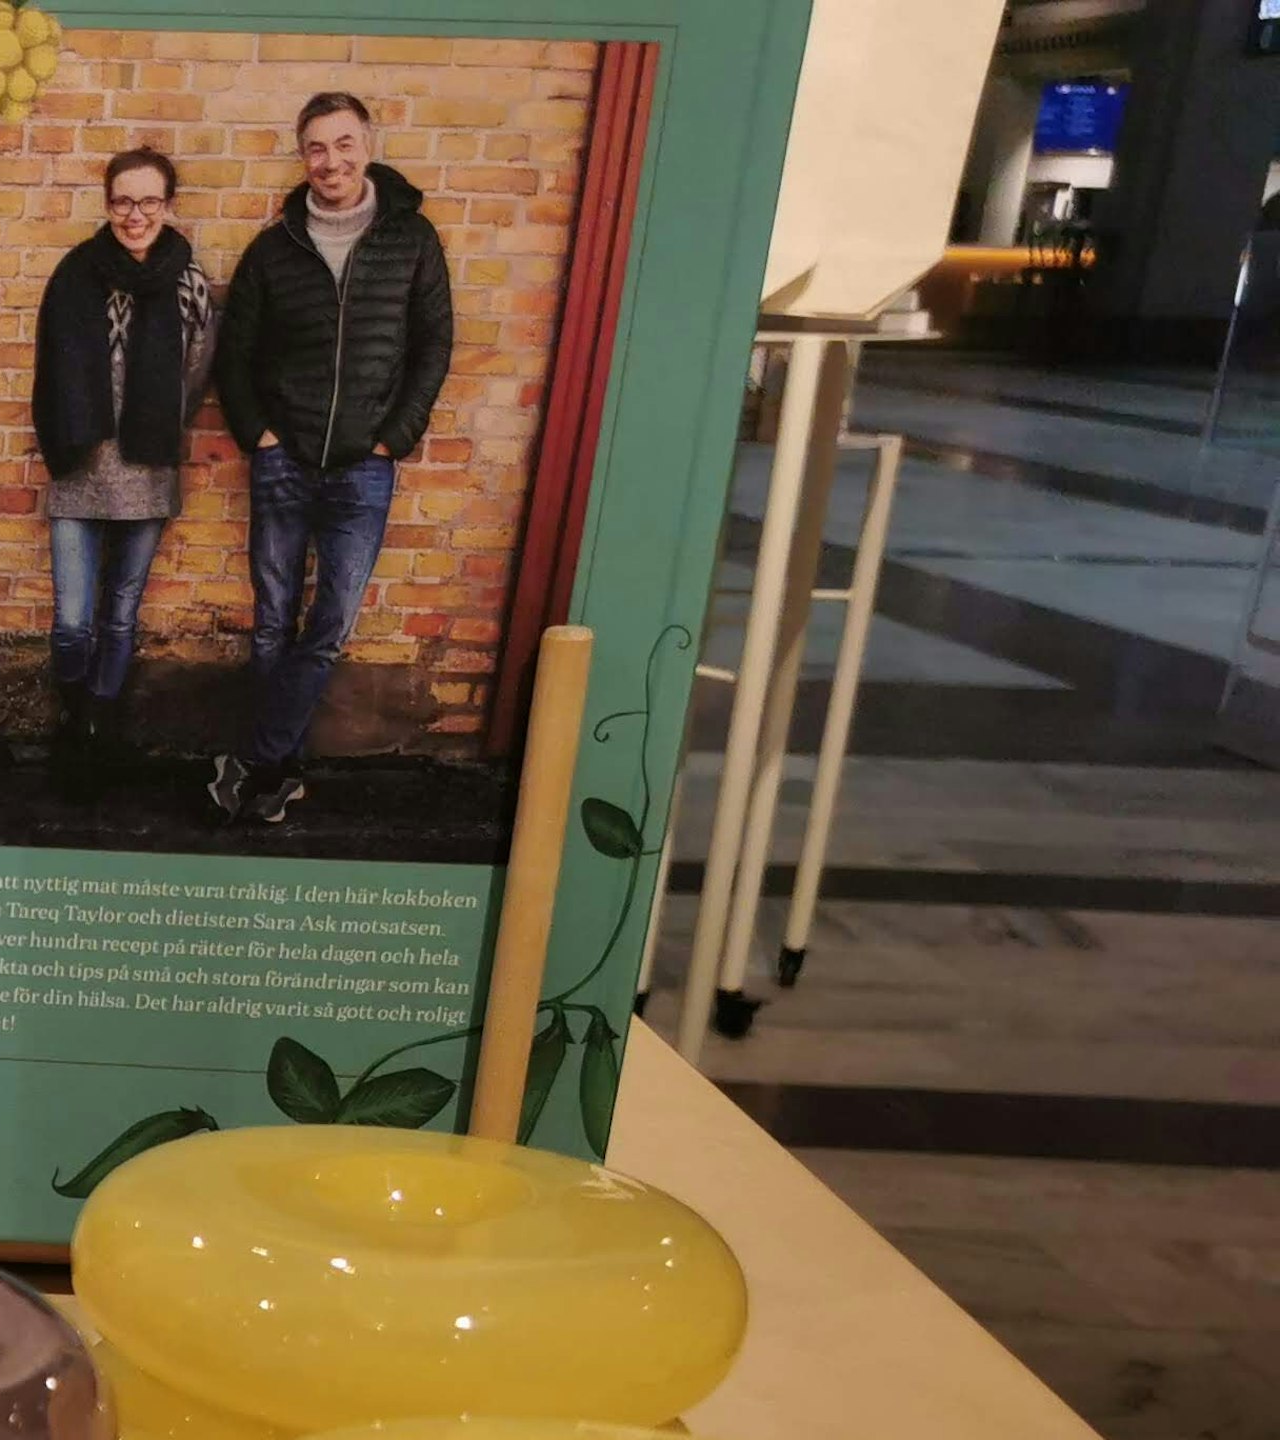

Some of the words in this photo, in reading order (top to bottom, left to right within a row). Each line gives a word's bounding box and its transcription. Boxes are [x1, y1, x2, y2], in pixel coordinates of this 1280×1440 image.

[24, 876, 79, 896] nyttig
[82, 879, 117, 895] mat
[123, 879, 180, 897] måste
[183, 884, 224, 899] vara
[229, 883, 288, 904] tråkig.
[305, 886, 340, 903] den
[345, 886, 379, 904] här
[382, 887, 477, 908] kokboken
[7, 902, 60, 923] Tareq
[64, 905, 126, 925] Taylor
[128, 908, 161, 925] och
[165, 909, 249, 929] dietisten
[253, 913, 295, 931] Sara
[300, 915, 337, 933] Ask
[340, 920, 446, 937] motsatsen.
[30, 931, 97, 950] hundra
[102, 938, 159, 957] recept
[163, 939, 186, 959] på
[190, 940, 244, 957] rätter
[248, 941, 275, 959] för
[279, 943, 317, 960] hela
[321, 944, 376, 965] dagen
[380, 948, 415, 964] och
[419, 948, 460, 966] hela
[32, 960, 64, 977] och
[69, 963, 104, 981] tips
[107, 964, 129, 983] på
[132, 966, 171, 983] små
[175, 968, 208, 985] och
[211, 972, 260, 987] stora
[265, 970, 386, 995] förändringar
[389, 980, 429, 993] som
[434, 977, 469, 995] kan
[13, 987, 39, 1004] för
[43, 989, 73, 1005] din
[78, 991, 131, 1009] hälsa.
[135, 993, 167, 1011] Det
[172, 994, 204, 1012] har
[207, 996, 263, 1018] aldrig
[265, 1001, 313, 1017] varit
[314, 1002, 333, 1018] så
[336, 1005, 375, 1021] gott
[377, 1004, 411, 1021] och
[416, 1005, 466, 1026] roligt
